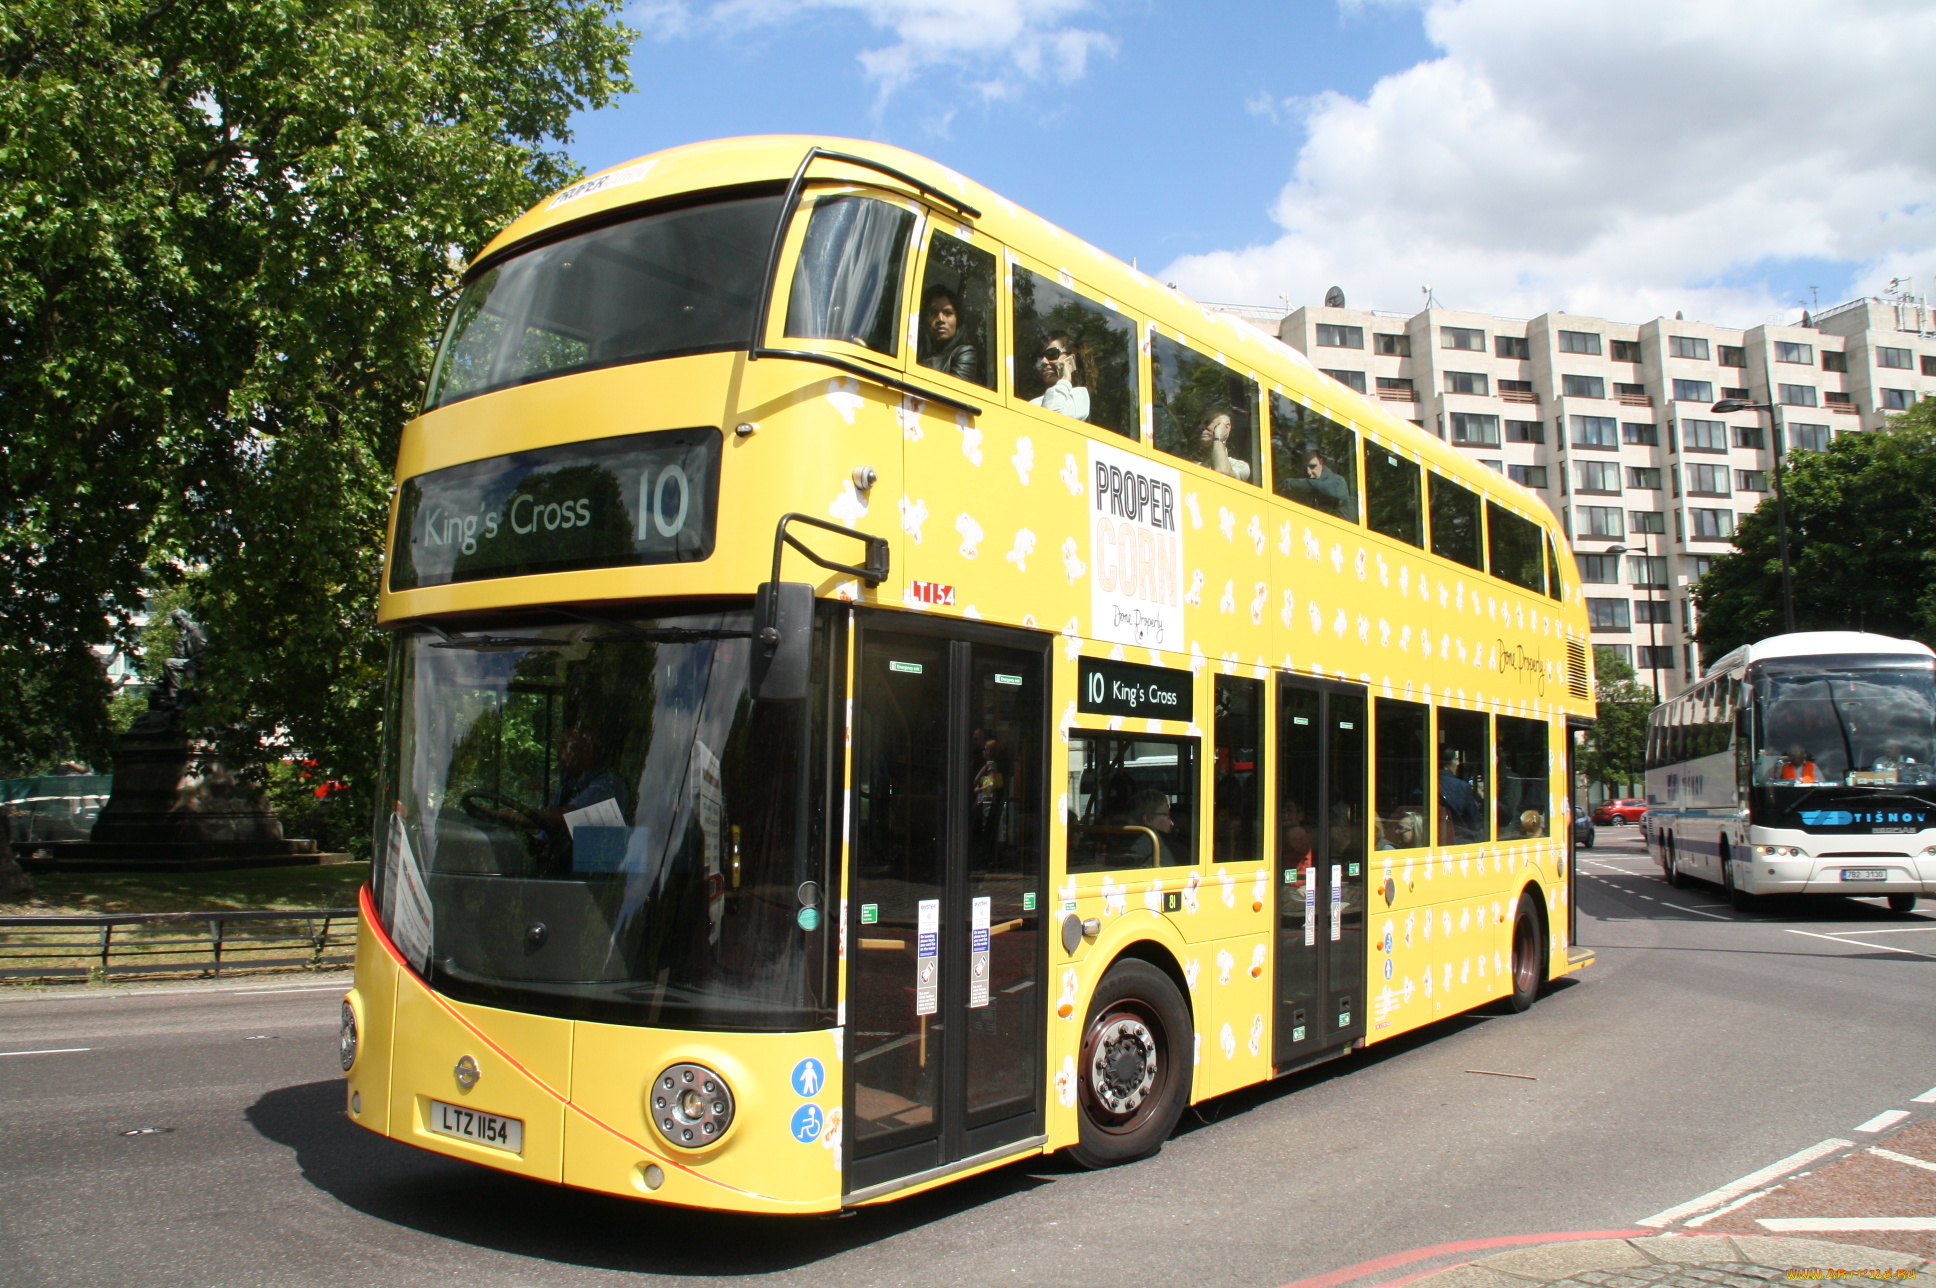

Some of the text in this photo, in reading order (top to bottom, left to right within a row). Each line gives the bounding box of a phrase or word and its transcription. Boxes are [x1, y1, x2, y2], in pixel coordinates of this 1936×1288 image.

[424, 464, 689, 556] King's Cross 10
[1095, 460, 1175, 532] PROPER
[1096, 517, 1177, 607] CORN
[910, 580, 955, 606] LT154
[1088, 671, 1178, 708] 10 King's Cross
[1854, 811, 1926, 823] TIŠNOV
[443, 1106, 508, 1145] LTZ 1154
